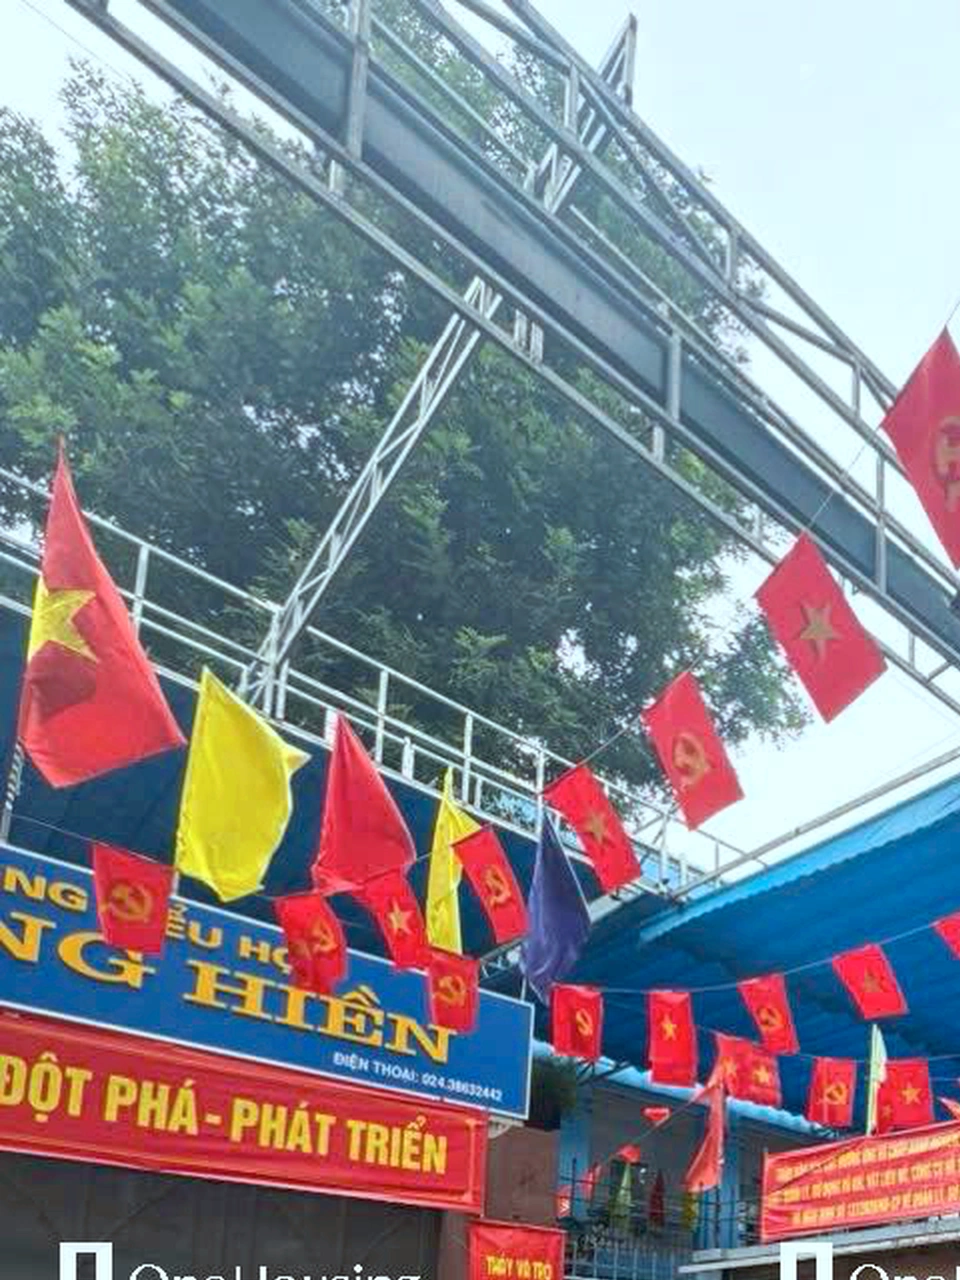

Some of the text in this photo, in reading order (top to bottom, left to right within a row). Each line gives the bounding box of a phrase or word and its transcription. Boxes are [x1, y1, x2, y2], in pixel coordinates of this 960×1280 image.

[183, 959, 458, 1064] HIỀN
[0, 1051, 93, 1123] ĐỘT
[104, 1073, 199, 1136] PHÁ
[230, 1097, 337, 1157] PHÁT
[346, 1113, 448, 1175] TRIỂN
